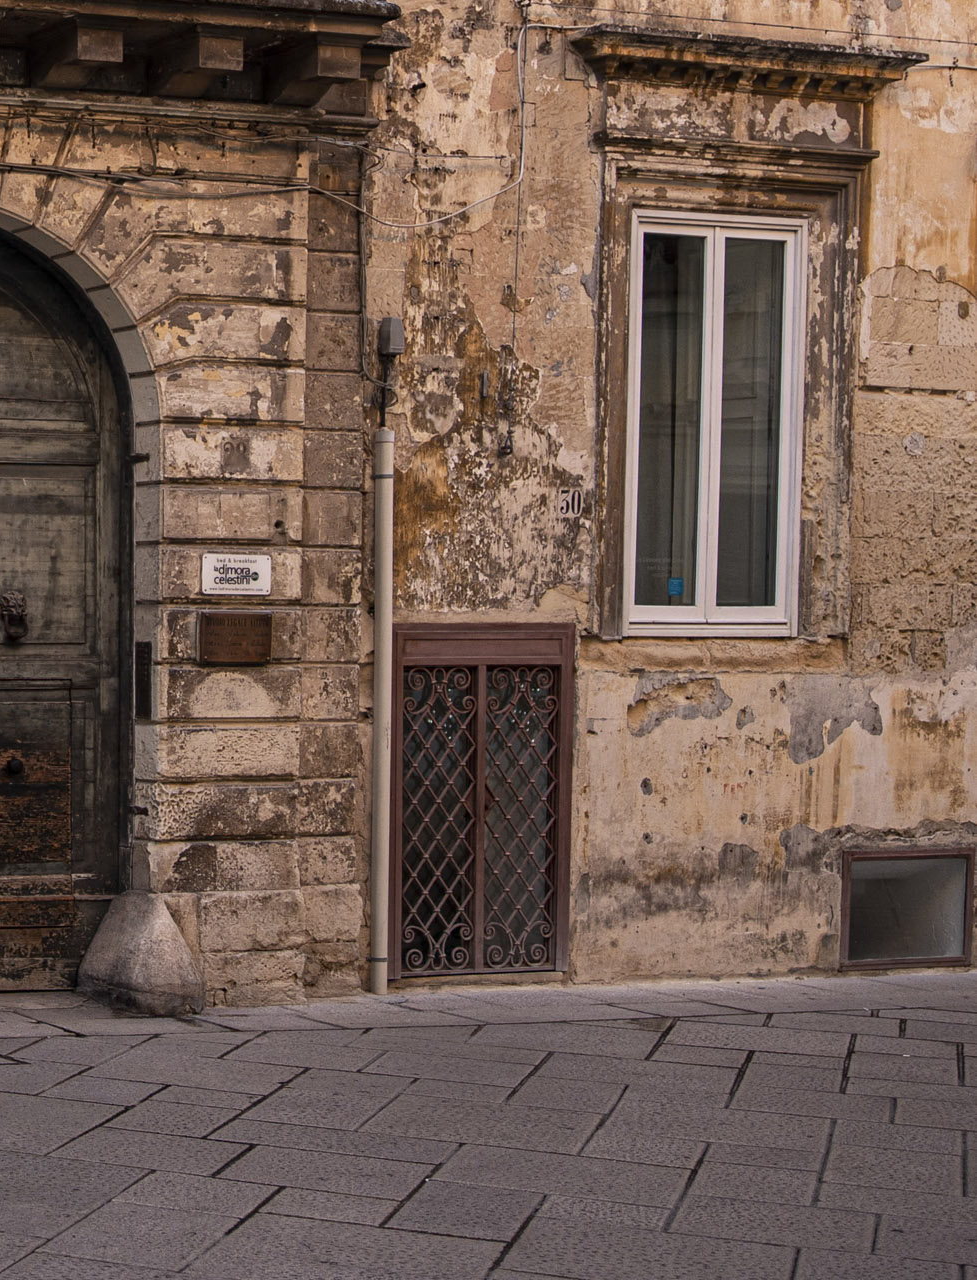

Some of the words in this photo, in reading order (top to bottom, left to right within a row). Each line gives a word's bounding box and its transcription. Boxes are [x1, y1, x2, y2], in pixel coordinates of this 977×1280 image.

[560, 490, 581, 515] 30
[218, 564, 250, 575] dimora
[214, 576, 250, 585] celestini
